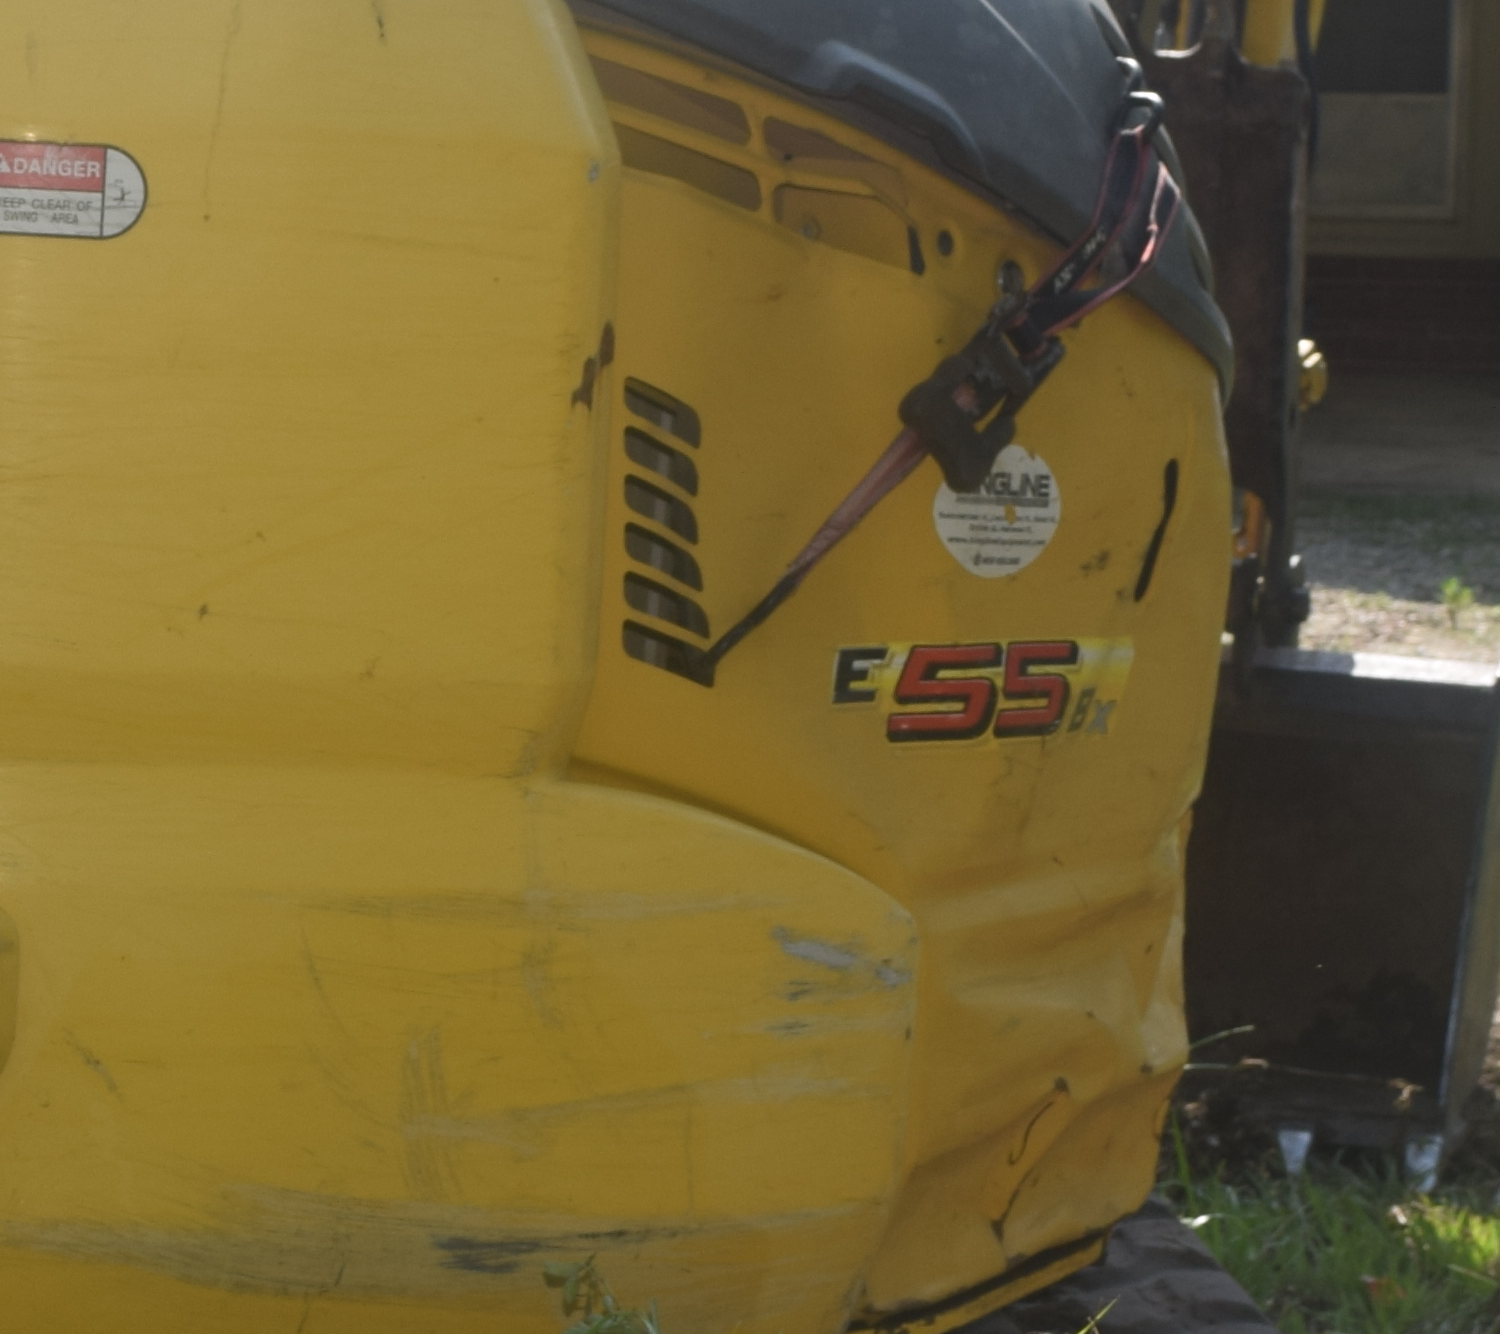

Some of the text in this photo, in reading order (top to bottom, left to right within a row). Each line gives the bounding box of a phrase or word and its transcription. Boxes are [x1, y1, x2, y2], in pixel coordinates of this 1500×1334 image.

[13, 157, 101, 179] DANGER
[31, 198, 71, 211] CLEAR
[76, 200, 93, 211] OF
[3, 210, 79, 225] SWING AREA
